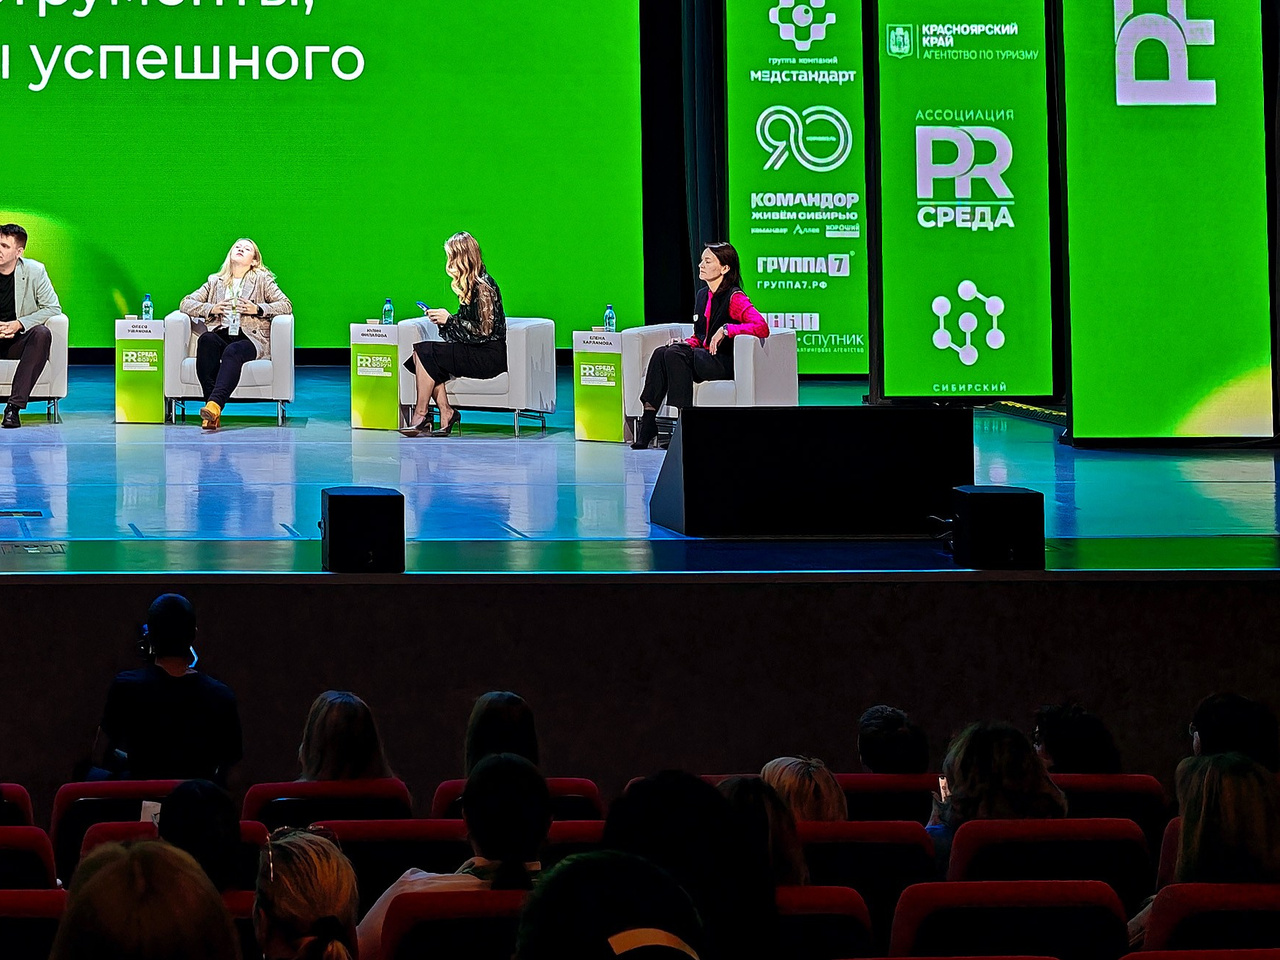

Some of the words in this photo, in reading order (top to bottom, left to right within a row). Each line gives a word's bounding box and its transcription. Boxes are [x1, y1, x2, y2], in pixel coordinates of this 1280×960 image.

[922, 22, 1018, 35] КРАСНОЯРСКИЙ
[922, 35, 954, 47] КРАЙ
[768, 57, 796, 65] группа
[799, 56, 838, 64] компаний
[979, 50, 994, 60] ПО
[996, 50, 1039, 60] ТУРИЗМУ
[27, 43, 365, 92] успешного
[915, 109, 1014, 122] АССОЦИАЦИЯ
[915, 125, 1014, 199] PR
[751, 193, 859, 209] КОМАНДОР
[751, 210, 797, 220] ЖИВЁМ
[798, 212, 858, 220] СИБИРЬЮ
[917, 206, 1015, 231] СРЕДА
[757, 280, 827, 289] ГРУППА7.РФ
[932, 382, 1007, 392] СИБИРСКИЙ
